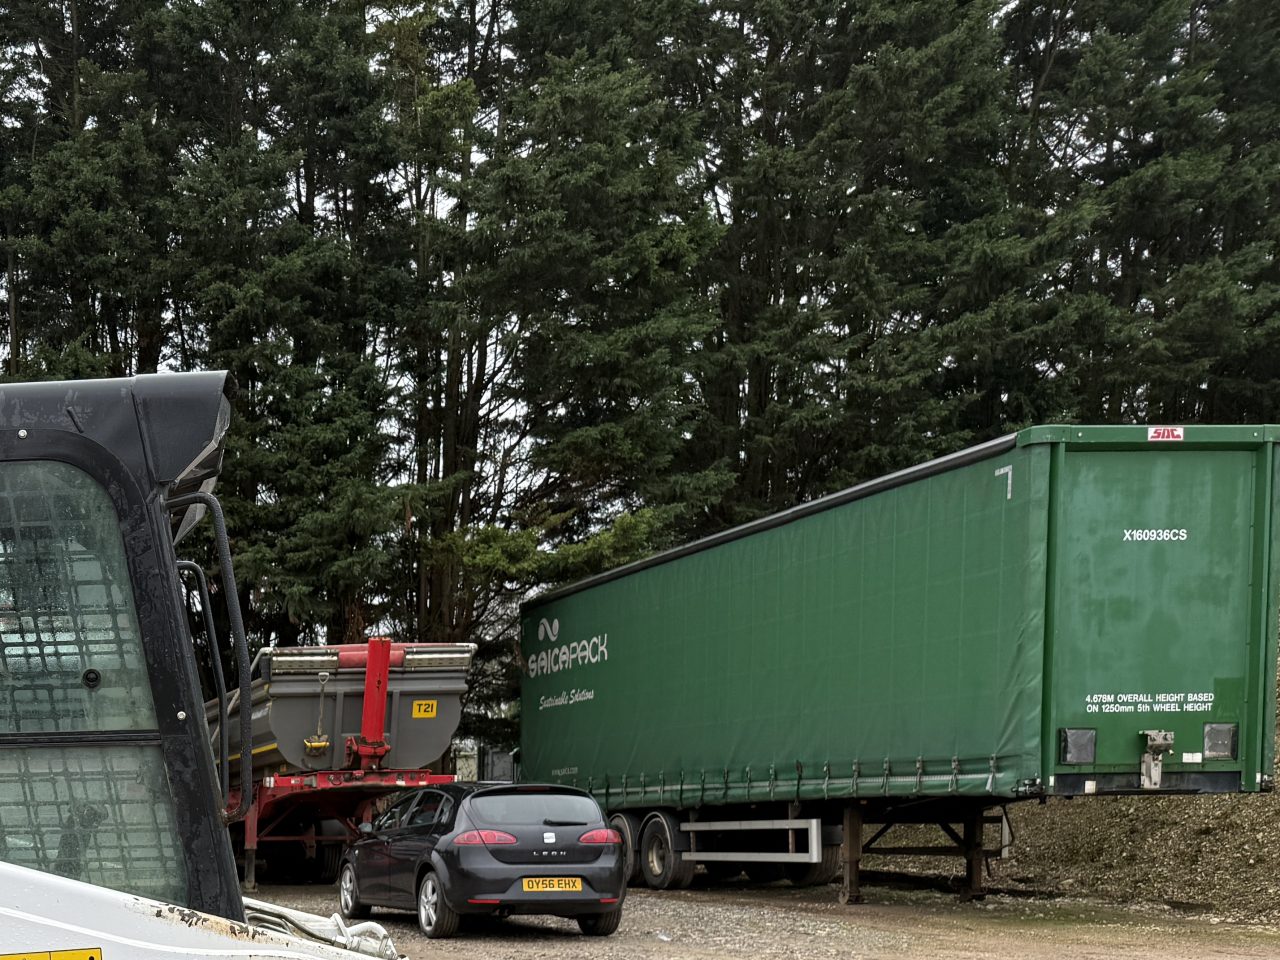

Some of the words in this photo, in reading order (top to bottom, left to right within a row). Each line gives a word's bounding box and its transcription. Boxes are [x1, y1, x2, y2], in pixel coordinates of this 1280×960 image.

[1123, 529, 1187, 541] X160936CS
[528, 633, 608, 678] SAICAPACK
[539, 691, 568, 710] Sustainable
[569, 689, 594, 705] Solutions
[1086, 694, 1114, 702] 4.678M
[1117, 694, 1152, 702] OVERALL
[1156, 693, 1184, 702] HEIGHT
[1188, 693, 1214, 701] BASED
[416, 703, 434, 713] T21
[1087, 704, 1098, 712] ON
[1102, 704, 1134, 712] 1250mm
[1137, 704, 1150, 712] 5th
[1153, 704, 1181, 712] WHEEL
[1184, 703, 1212, 711] HEIGHT
[527, 879, 555, 889] OY56
[557, 879, 577, 889] EHX
